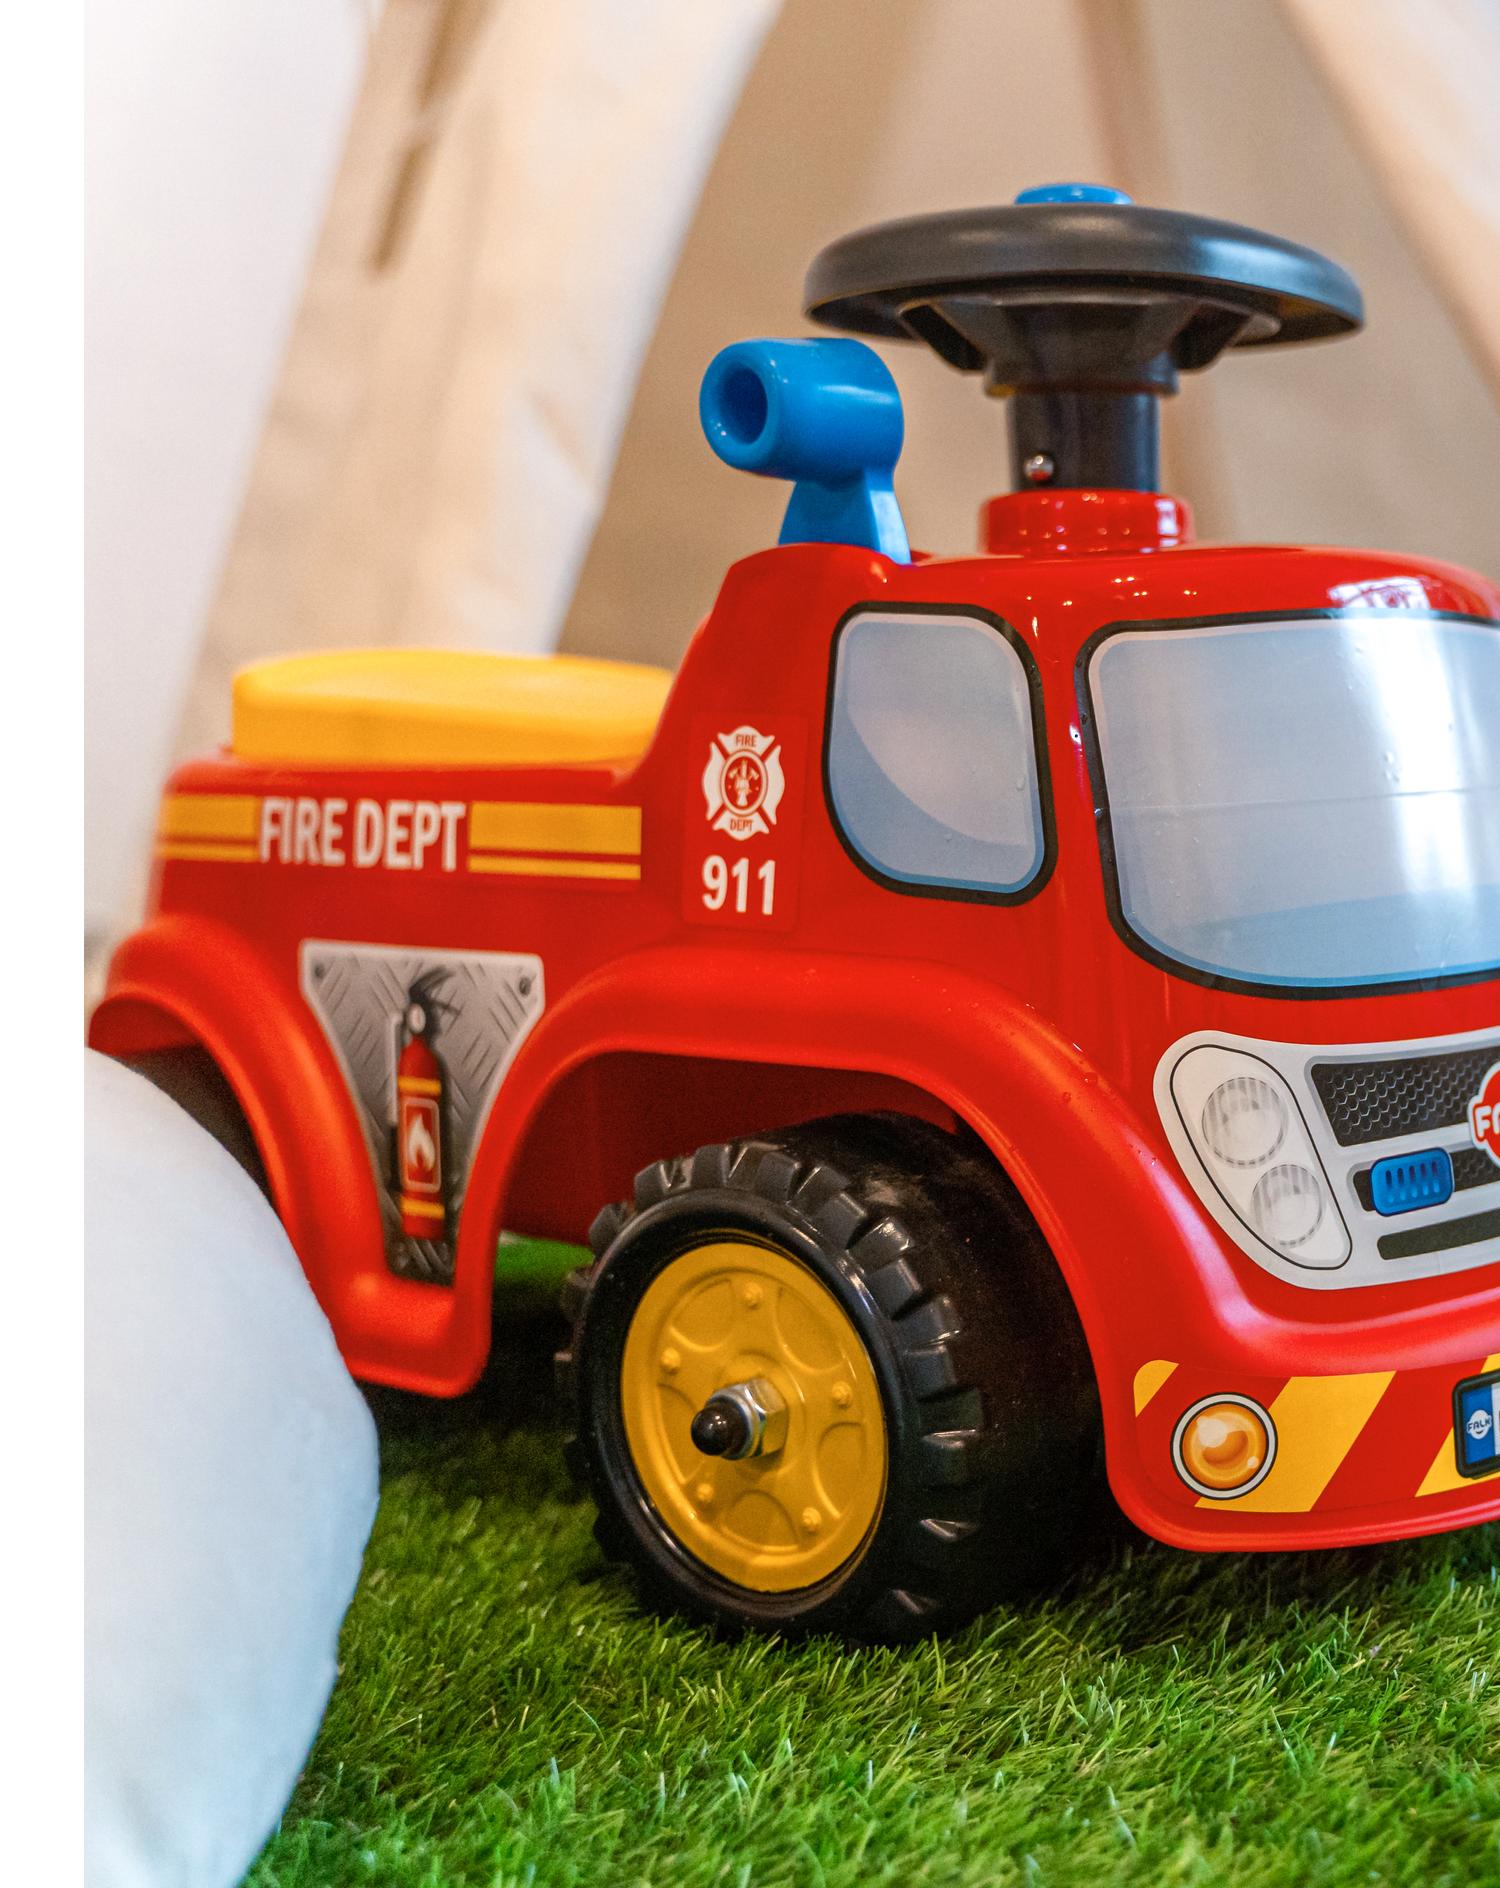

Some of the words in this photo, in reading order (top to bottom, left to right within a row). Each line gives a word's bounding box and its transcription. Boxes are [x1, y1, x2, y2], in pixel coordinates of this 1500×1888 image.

[735, 734, 757, 747] FIRE
[729, 818, 753, 831] DEPT
[260, 796, 348, 867] FIRE
[353, 798, 467, 873] DEPT
[702, 855, 776, 915] 911
[1467, 1418, 1490, 1432] FALK
